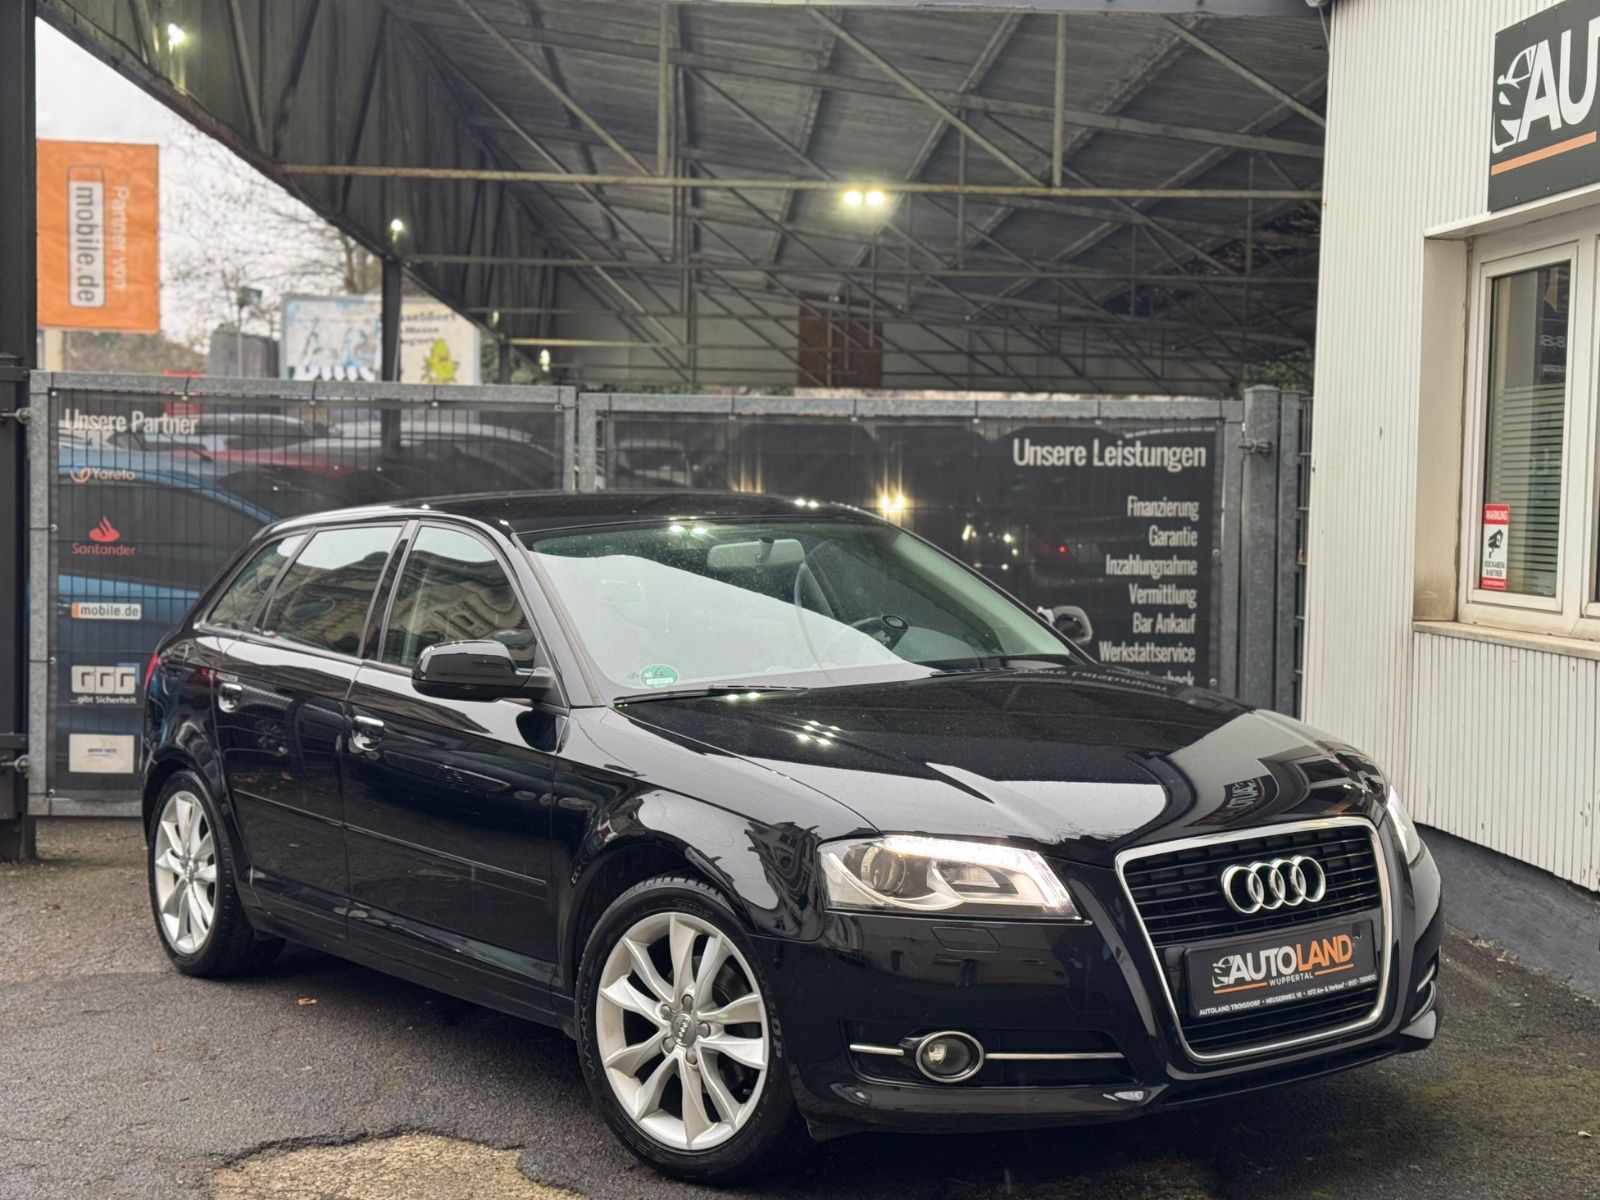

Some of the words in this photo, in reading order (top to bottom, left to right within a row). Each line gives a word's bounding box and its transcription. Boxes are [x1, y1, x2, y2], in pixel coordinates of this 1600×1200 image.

[111, 186, 130, 252] Partner
[75, 186, 100, 302] mobile.de
[65, 408, 127, 432] Unsere
[131, 410, 199, 434] Partner
[1013, 438, 1087, 466] Unsere
[1093, 438, 1206, 473] Leistungen
[1127, 495, 1200, 522] Finanzierung
[1148, 524, 1198, 547] Garantie
[72, 543, 136, 556] Santander
[1106, 554, 1198, 580] Inzahlungnahme
[1128, 583, 1198, 609] Vermittlung
[80, 605, 139, 617] mobile.de
[1132, 611, 1154, 634] Bar
[1156, 612, 1197, 634] Ankauf
[1098, 641, 1196, 663] Werkstattservice
[1227, 933, 1353, 984] AUTOLAND
[1269, 971, 1314, 987] WUPPERTAL
[1199, 1004, 1230, 1016] AUTOLAND
[1230, 1000, 1261, 1012] TROISDORF
